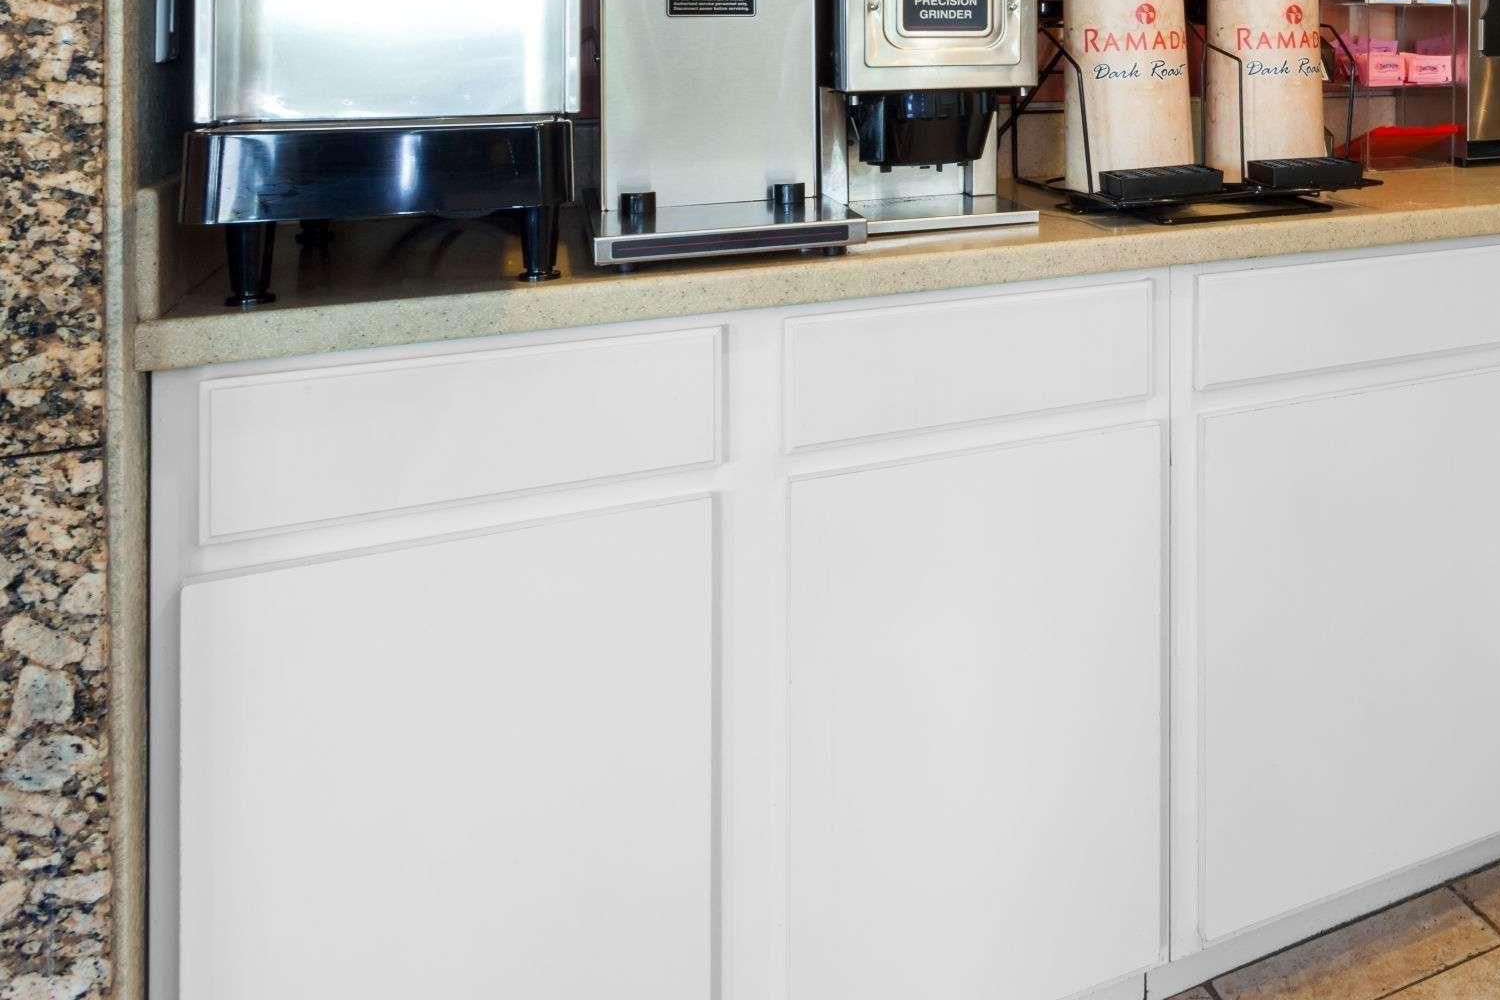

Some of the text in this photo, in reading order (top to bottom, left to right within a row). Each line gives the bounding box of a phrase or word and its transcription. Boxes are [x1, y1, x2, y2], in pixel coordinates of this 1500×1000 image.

[919, 9, 973, 20] GRINDER
[1235, 27, 1320, 50] RAMAD
[1094, 59, 1186, 80] Dark Roast
[1246, 59, 1290, 76] Dark
